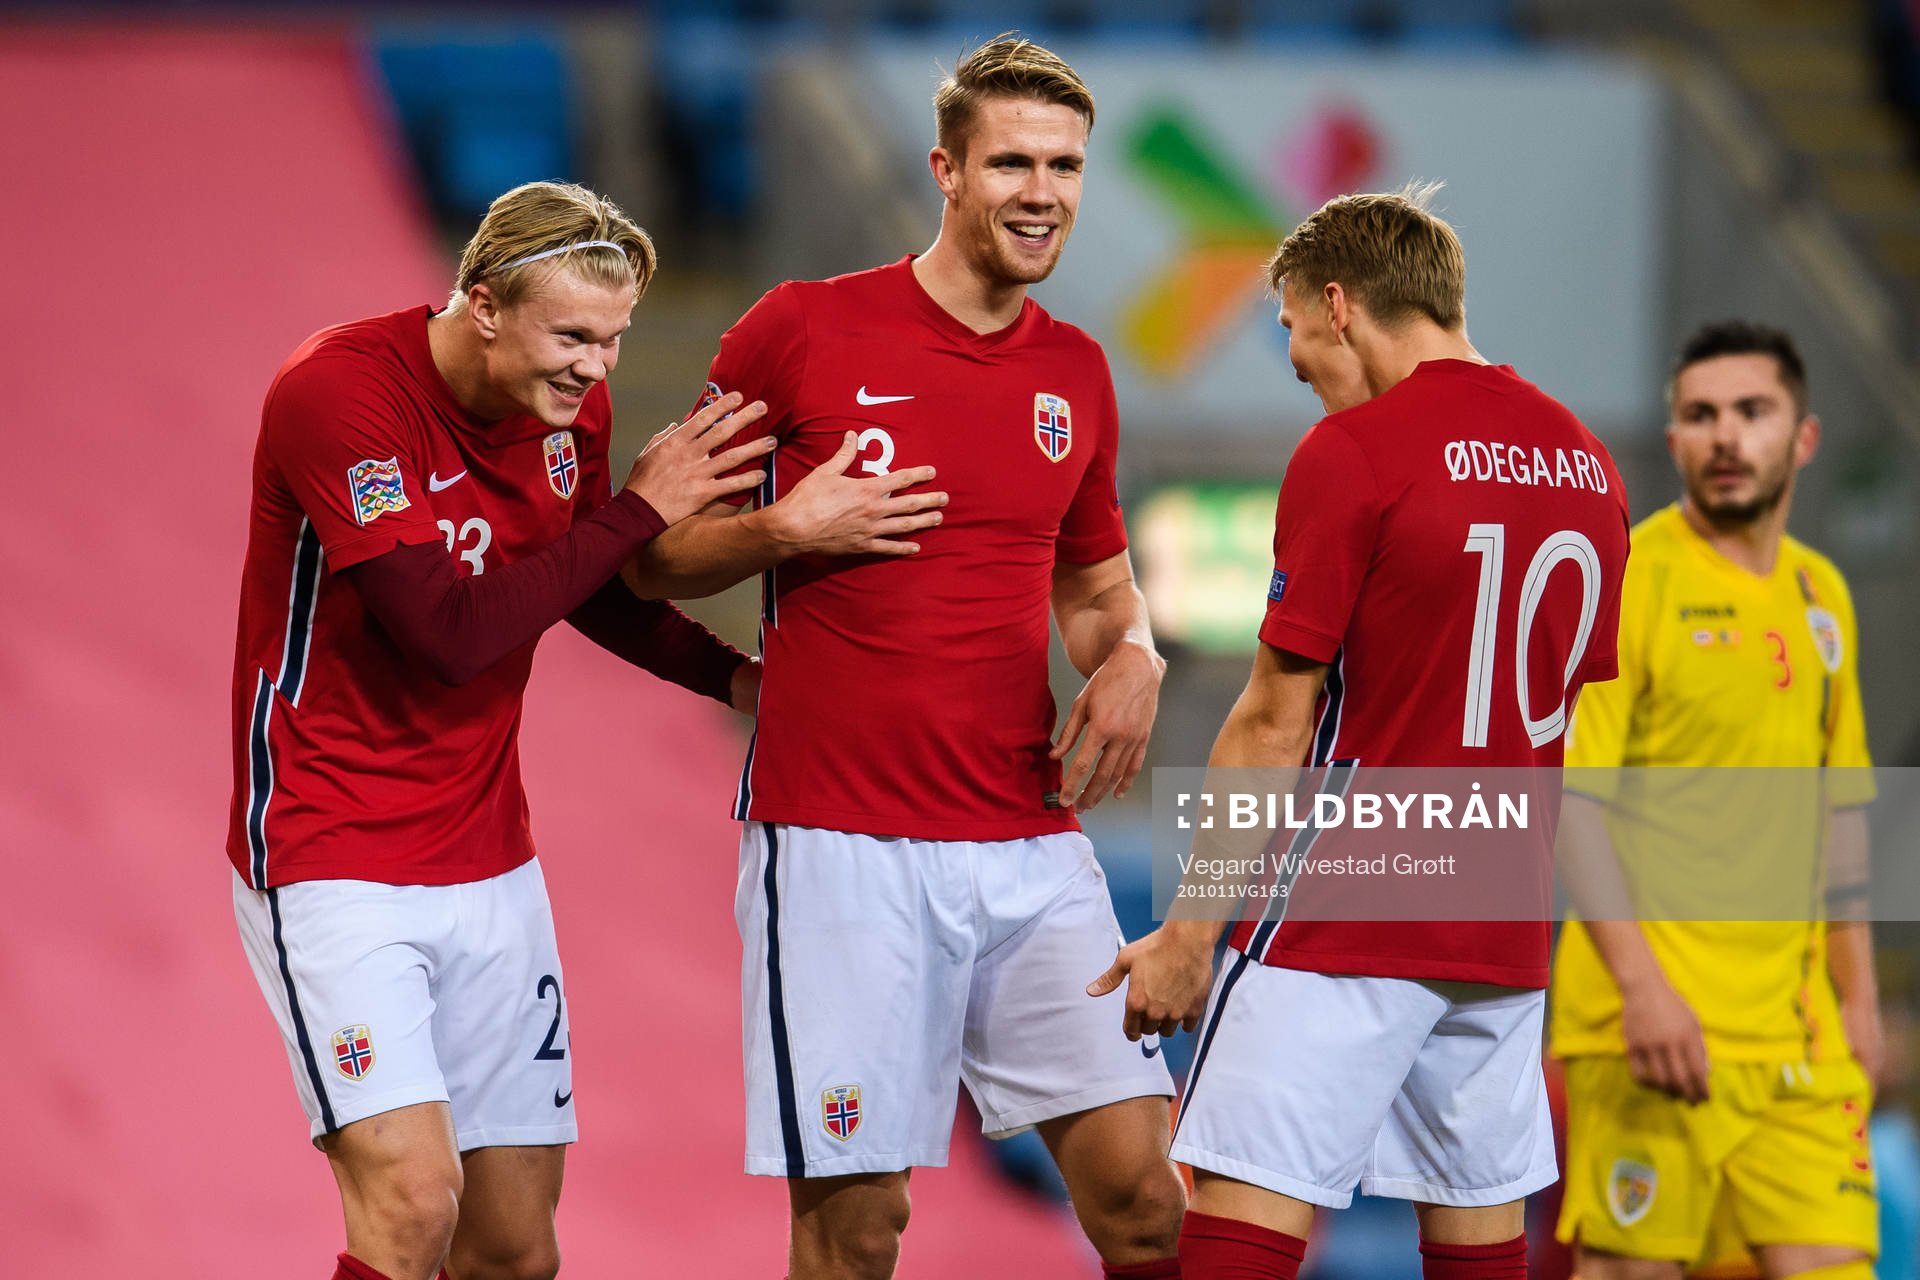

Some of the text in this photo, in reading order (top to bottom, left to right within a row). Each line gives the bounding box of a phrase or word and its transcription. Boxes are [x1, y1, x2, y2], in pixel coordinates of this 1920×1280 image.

[857, 428, 895, 500] 3
[1444, 440, 1608, 495] ØDEGAARD
[1462, 523, 1602, 749] 10
[1764, 630, 1793, 690] 3
[533, 974, 571, 1060] 2
